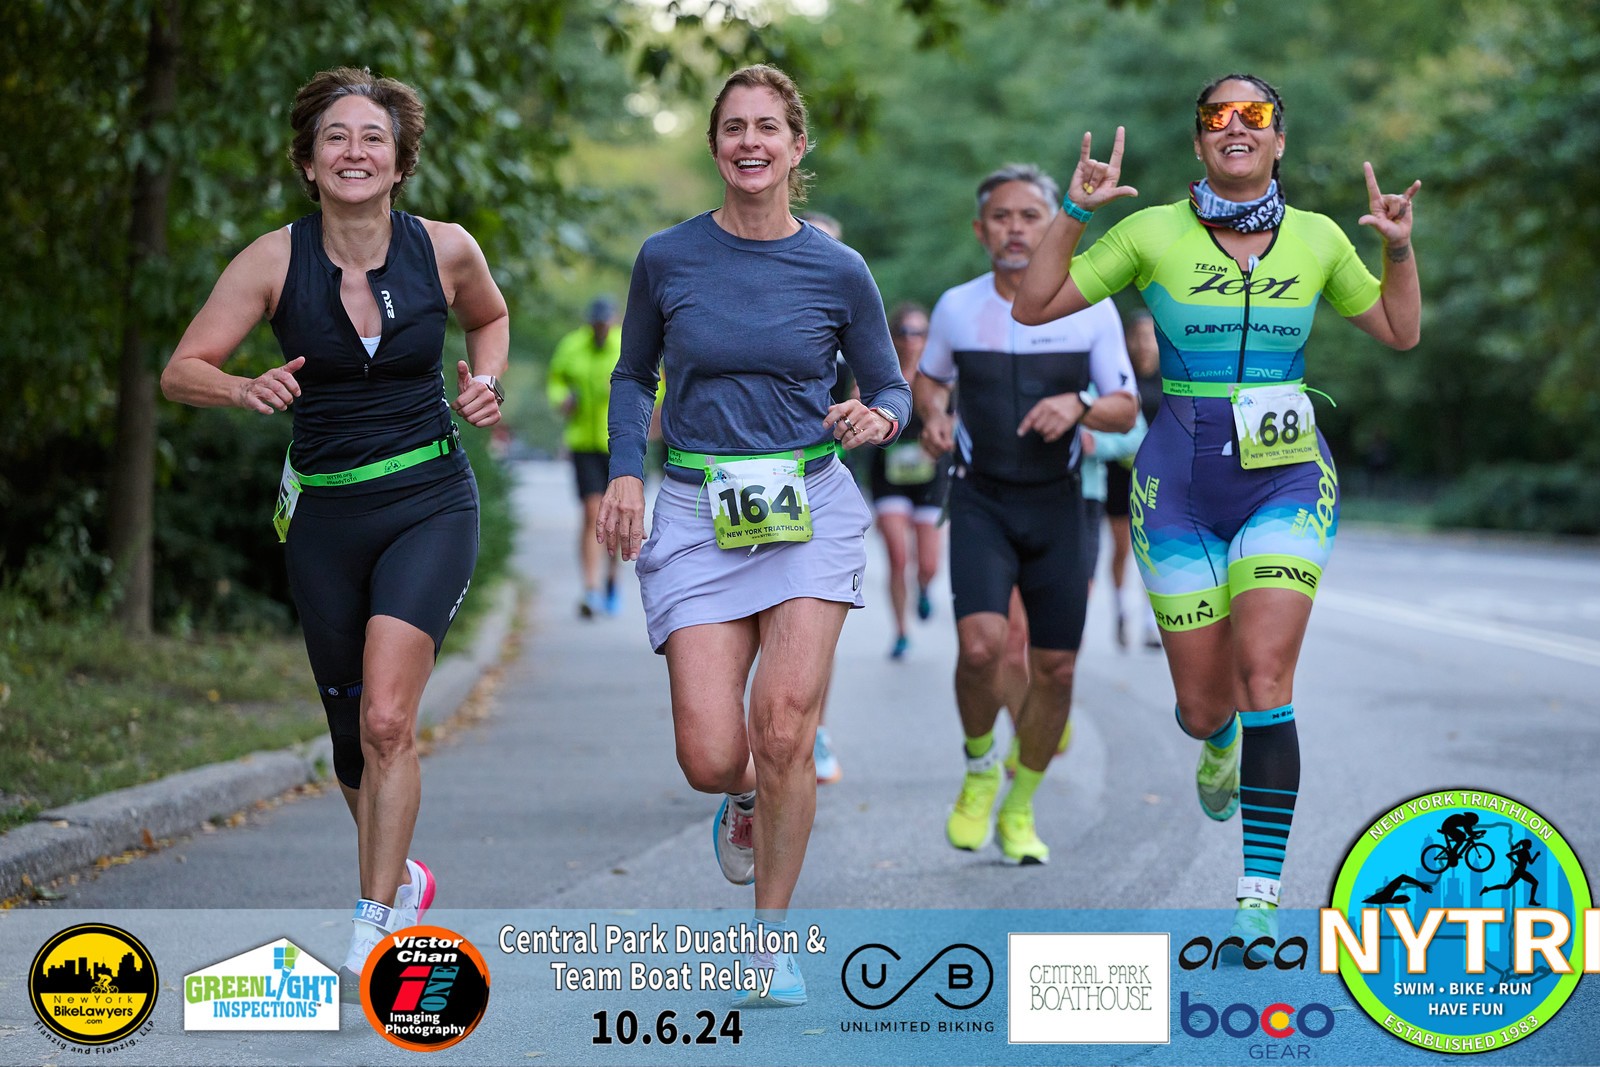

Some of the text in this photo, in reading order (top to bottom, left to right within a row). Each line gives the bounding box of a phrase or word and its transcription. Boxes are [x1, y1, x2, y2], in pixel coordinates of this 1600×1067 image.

[1195, 263, 1228, 273] TEAM
[381, 290, 395, 318] 2XU
[1185, 323, 1301, 336] QUINTANA ROO
[1193, 367, 1233, 378] GARMIN
[1259, 409, 1299, 447] 68
[1282, 446, 1312, 454] TRIATHLON
[1148, 478, 1160, 510] TEAM
[718, 484, 802, 526] 164
[1290, 508, 1309, 536] TEAM
[726, 530, 742, 538] NEW
[744, 528, 762, 536] YORK
[361, 903, 384, 922] 155
